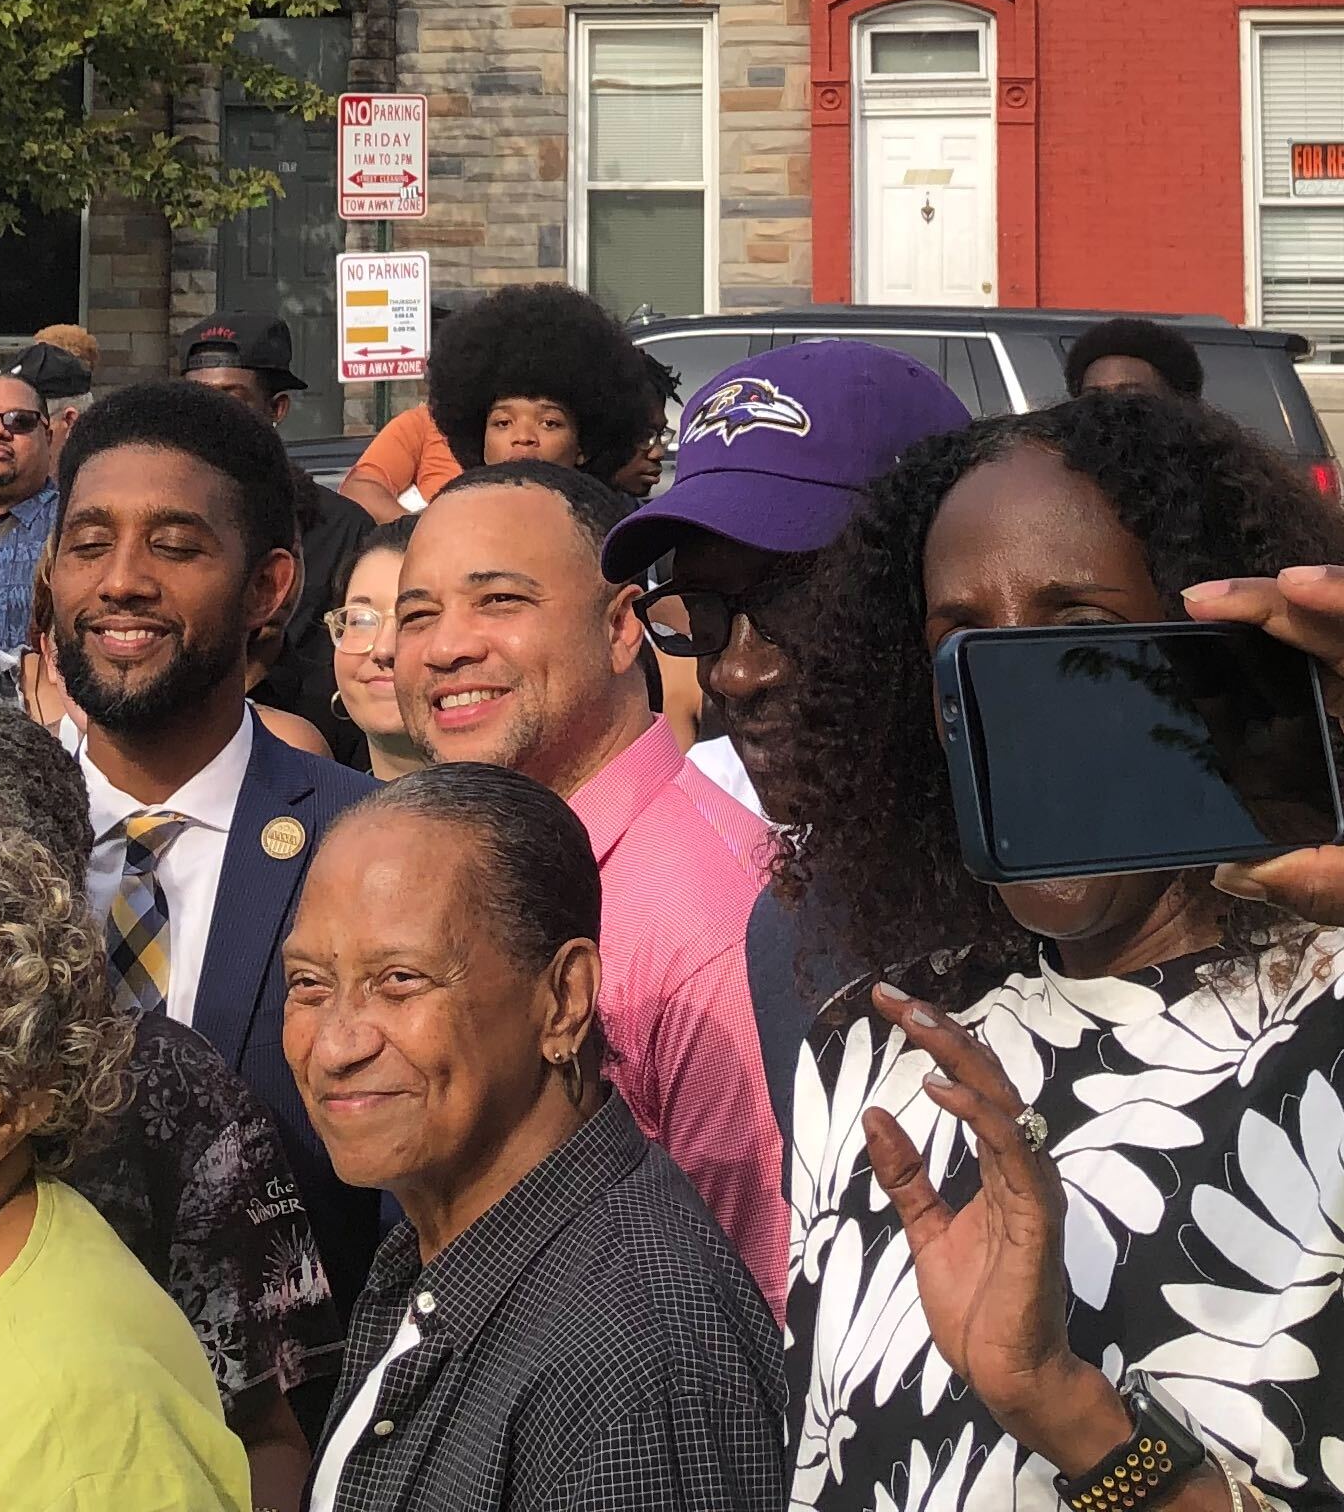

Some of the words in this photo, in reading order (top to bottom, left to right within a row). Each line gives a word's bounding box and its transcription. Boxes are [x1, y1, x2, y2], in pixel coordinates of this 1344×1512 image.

[344, 100, 371, 125] NO
[373, 104, 421, 122] PARKING
[354, 132, 411, 147] FRIDAY
[379, 154, 390, 165] TO
[1294, 144, 1323, 178] FOR
[346, 199, 365, 211] TOW
[368, 199, 394, 211] AWAY
[397, 199, 421, 211] ZONE
[347, 264, 364, 281] NO
[368, 262, 420, 280] PARKING
[347, 363, 366, 376] TOW
[368, 362, 395, 375] AWAY
[397, 360, 422, 373] ZONE
